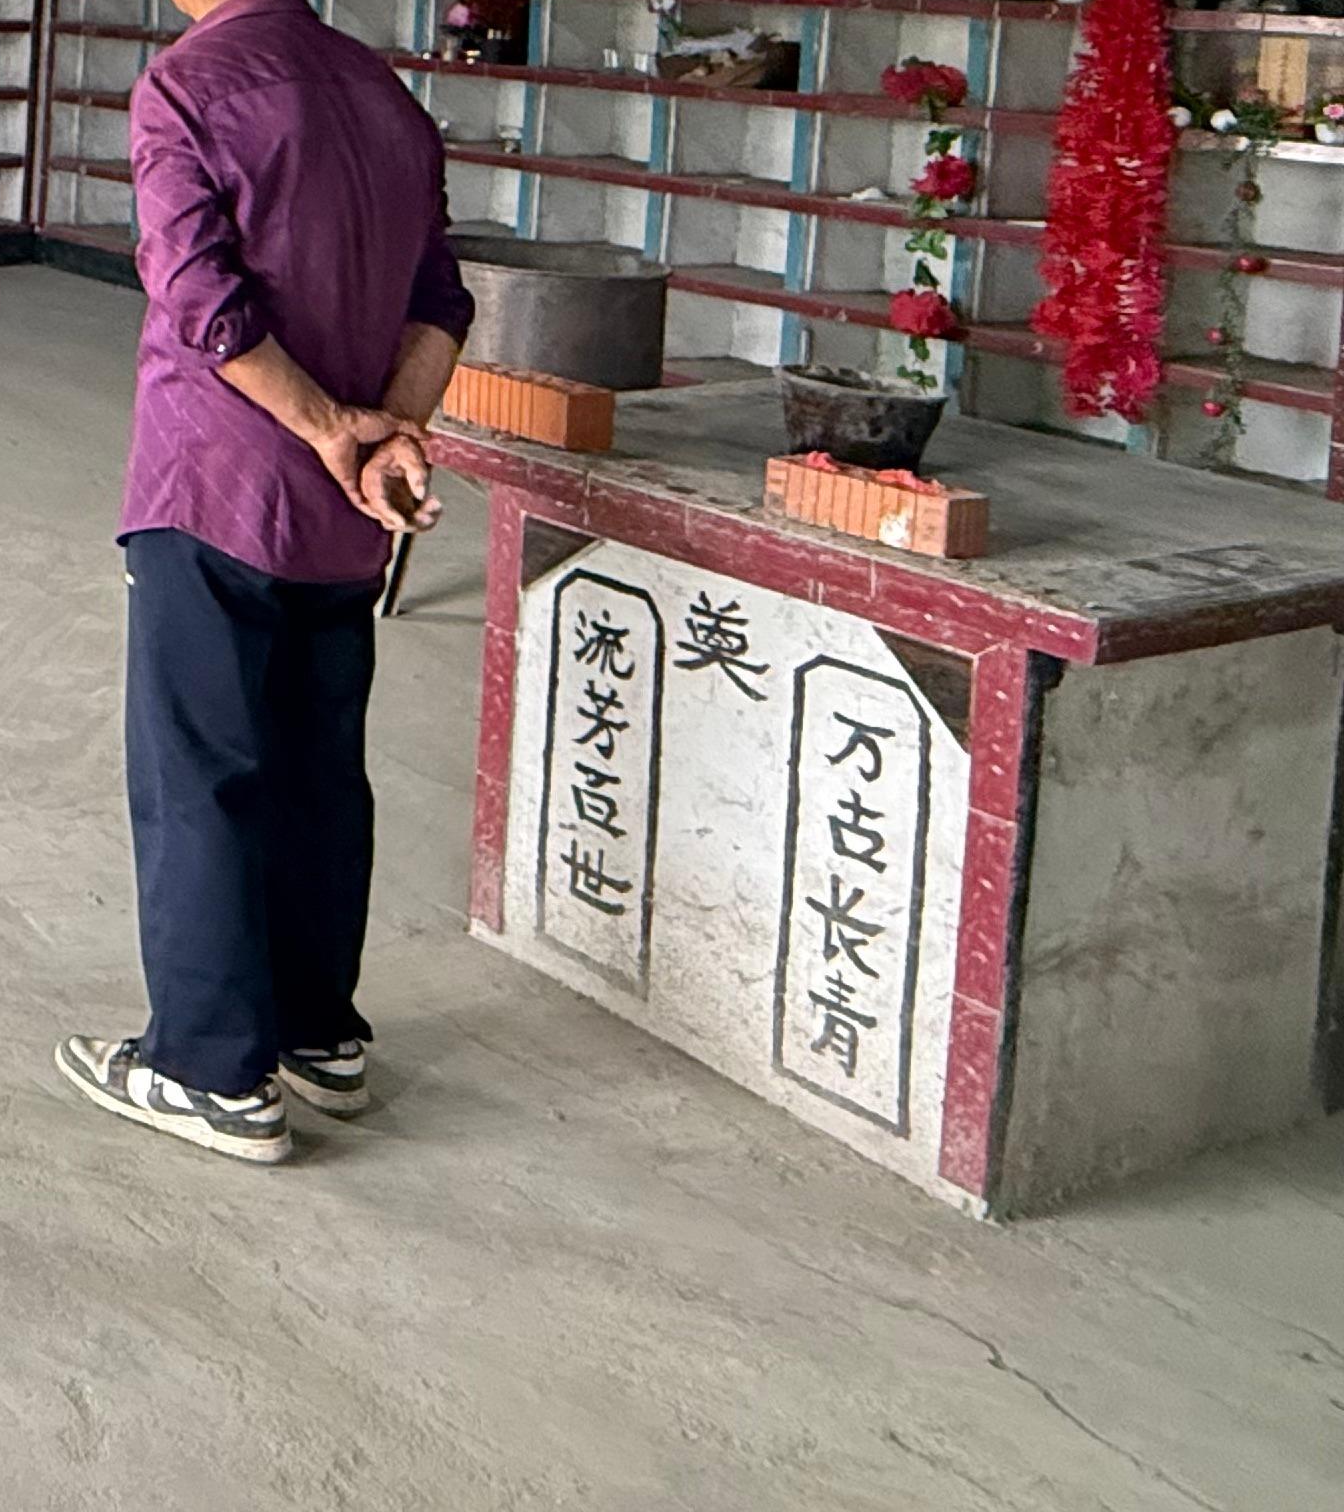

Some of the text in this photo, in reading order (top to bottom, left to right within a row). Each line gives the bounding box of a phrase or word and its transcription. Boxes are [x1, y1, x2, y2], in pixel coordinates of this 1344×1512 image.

[561, 609, 635, 916] 流芳百世
[805, 711, 896, 1078] 万古长青
